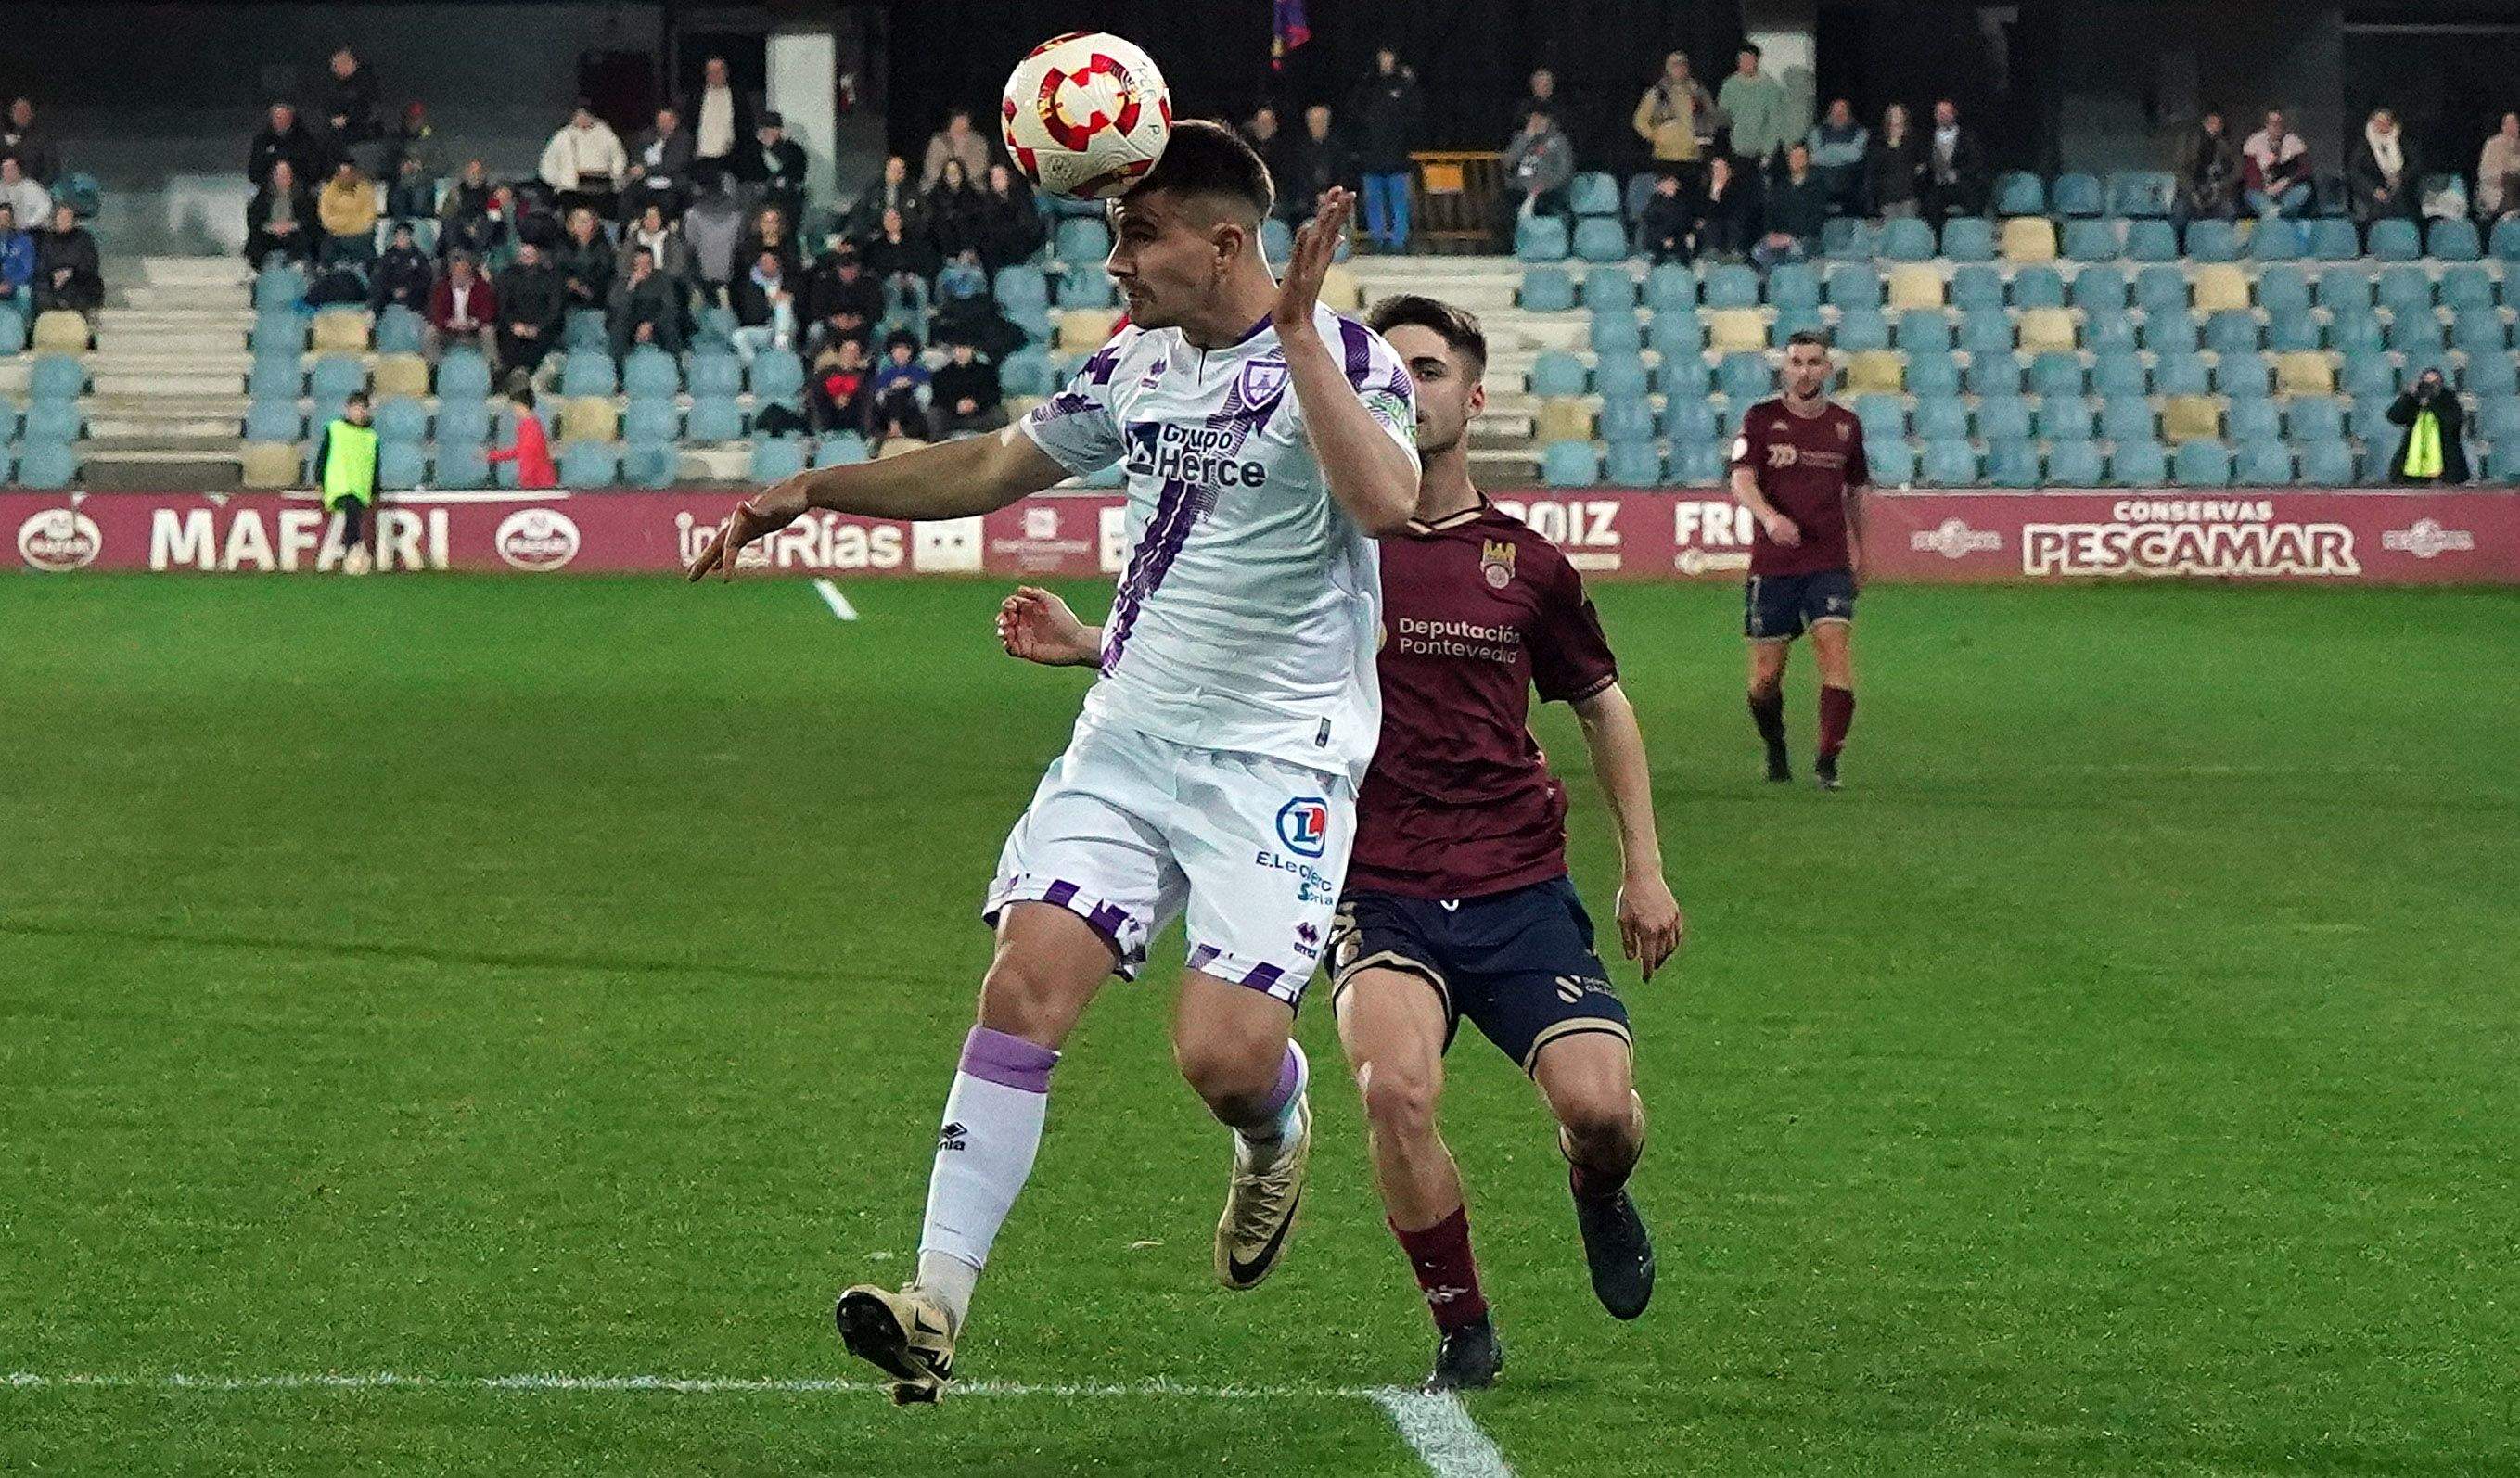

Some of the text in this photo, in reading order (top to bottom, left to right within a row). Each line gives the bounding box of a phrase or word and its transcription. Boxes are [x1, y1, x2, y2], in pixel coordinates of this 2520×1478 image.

[1162, 424, 1233, 455] Grupo
[1158, 446, 1267, 488] Herce
[2113, 501, 2275, 522] CONSERVAS
[2022, 523, 2361, 576] PESCAMAR
[1399, 618, 1521, 643] Deputación
